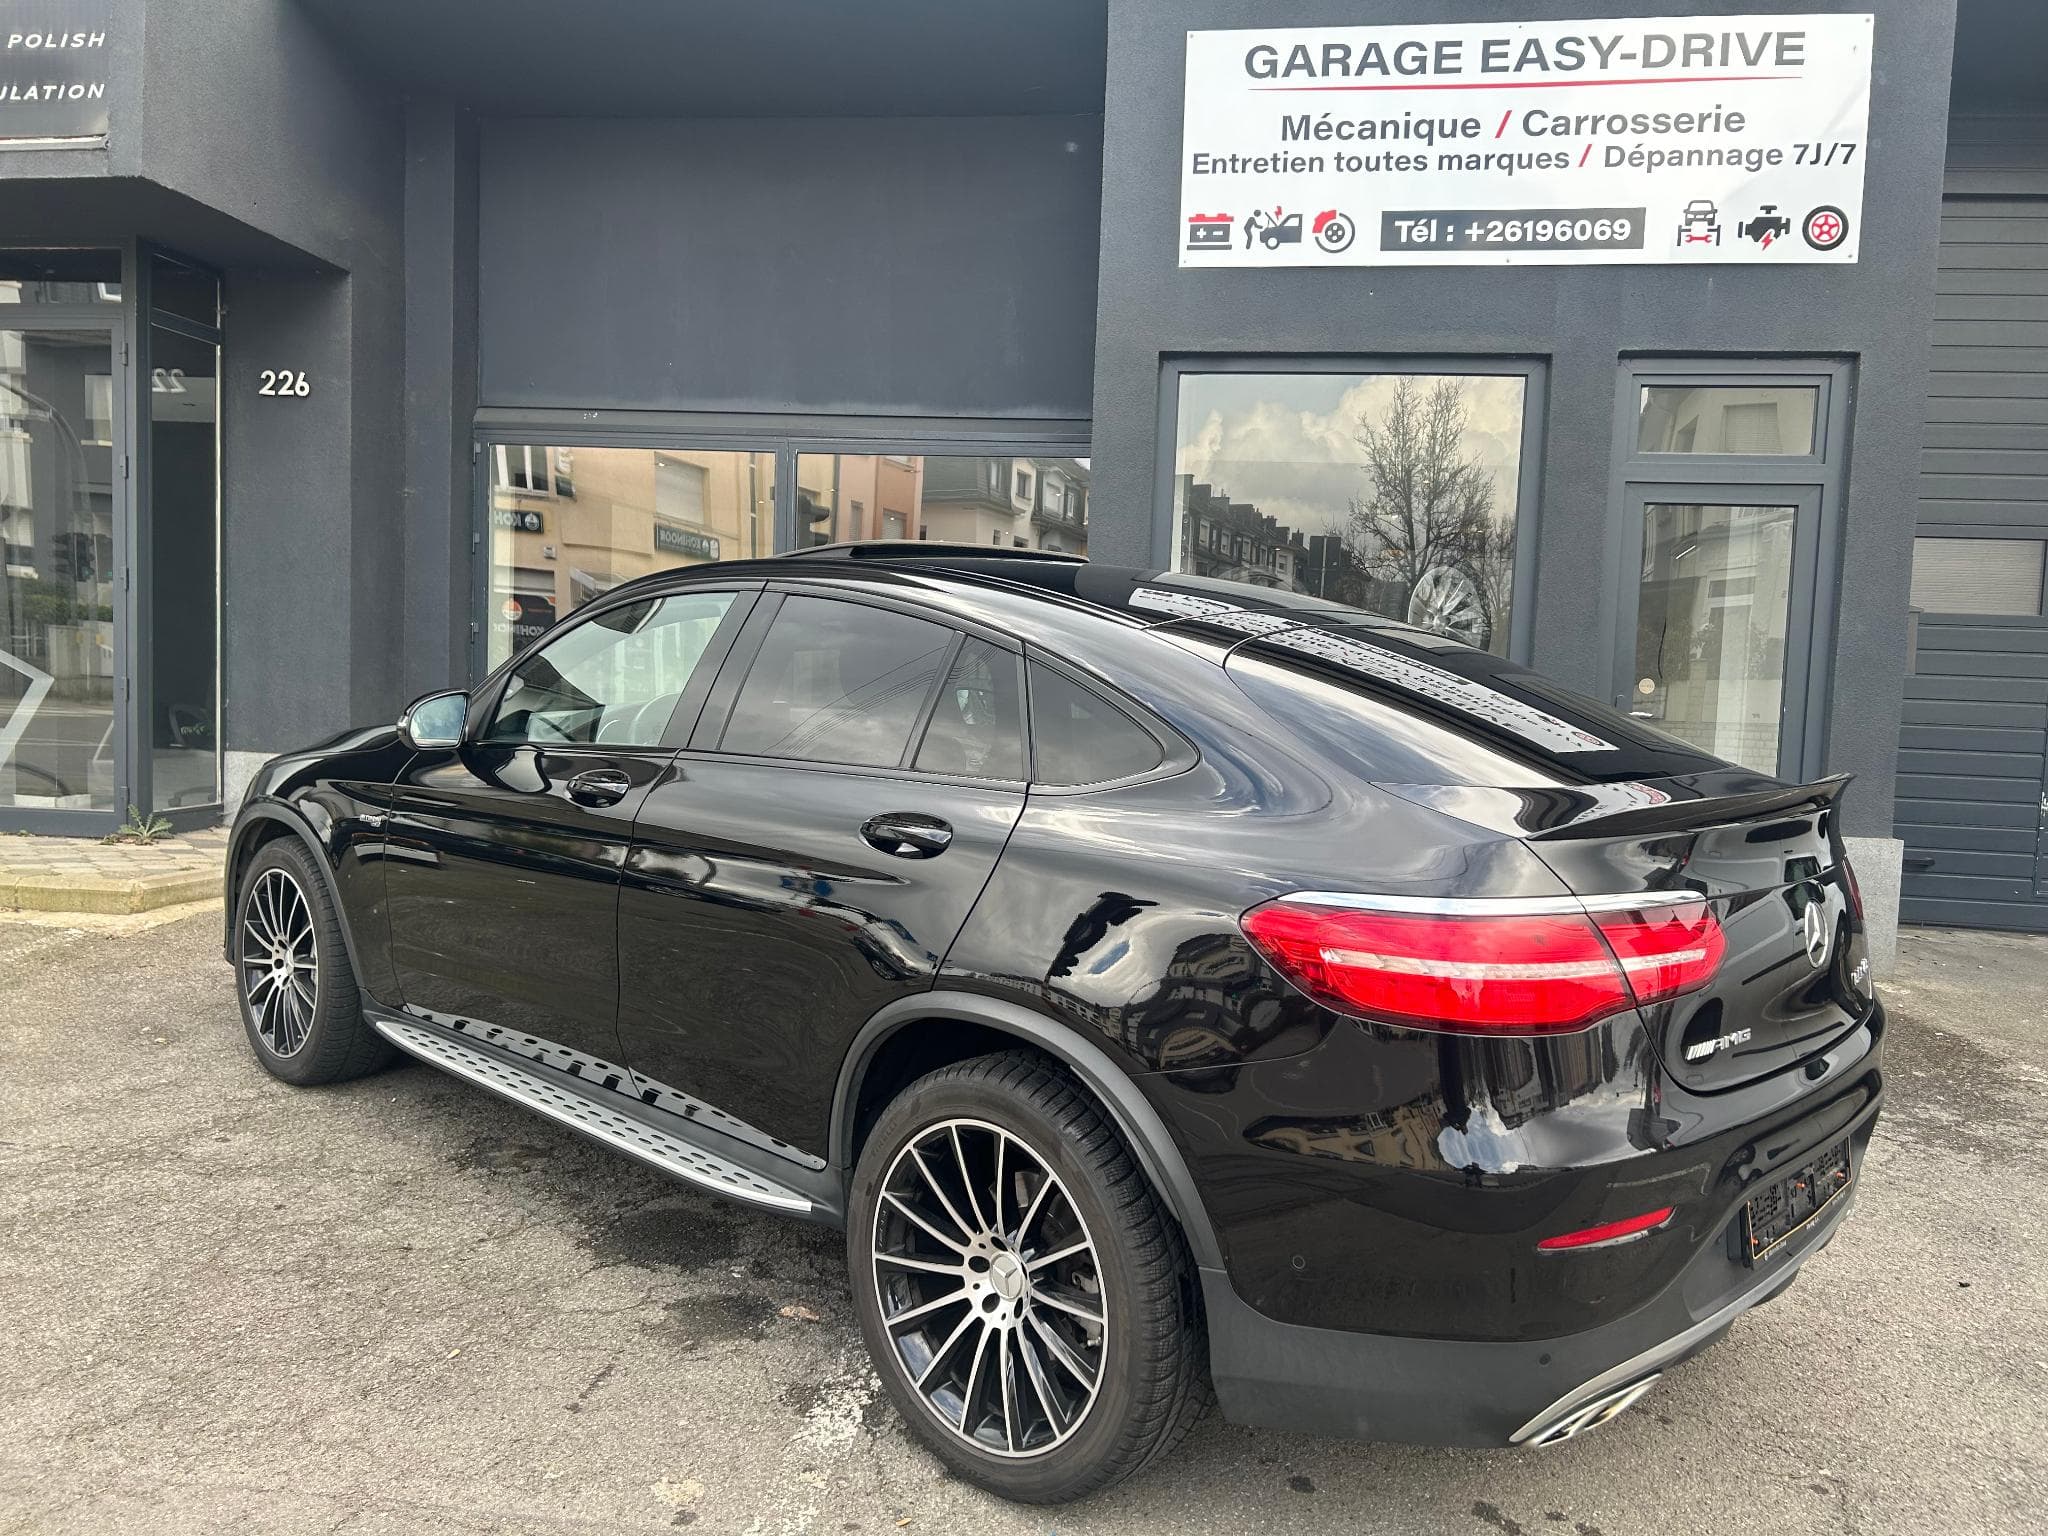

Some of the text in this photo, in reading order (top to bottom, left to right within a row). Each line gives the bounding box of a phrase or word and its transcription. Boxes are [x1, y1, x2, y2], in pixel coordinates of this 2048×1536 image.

[7, 32, 106, 49] POLISH
[1244, 31, 1807, 79] GARAGE EASY-DRIVE
[1281, 105, 1747, 147] Mécanique / Carrosserie
[1192, 142, 1858, 176] Entretien toutes marques / Dépannage 7J/7
[1394, 218, 1439, 243] Tél
[1464, 218, 1632, 243] +26196069
[258, 370, 311, 397] 226
[1710, 1027, 1752, 1054] AMG
